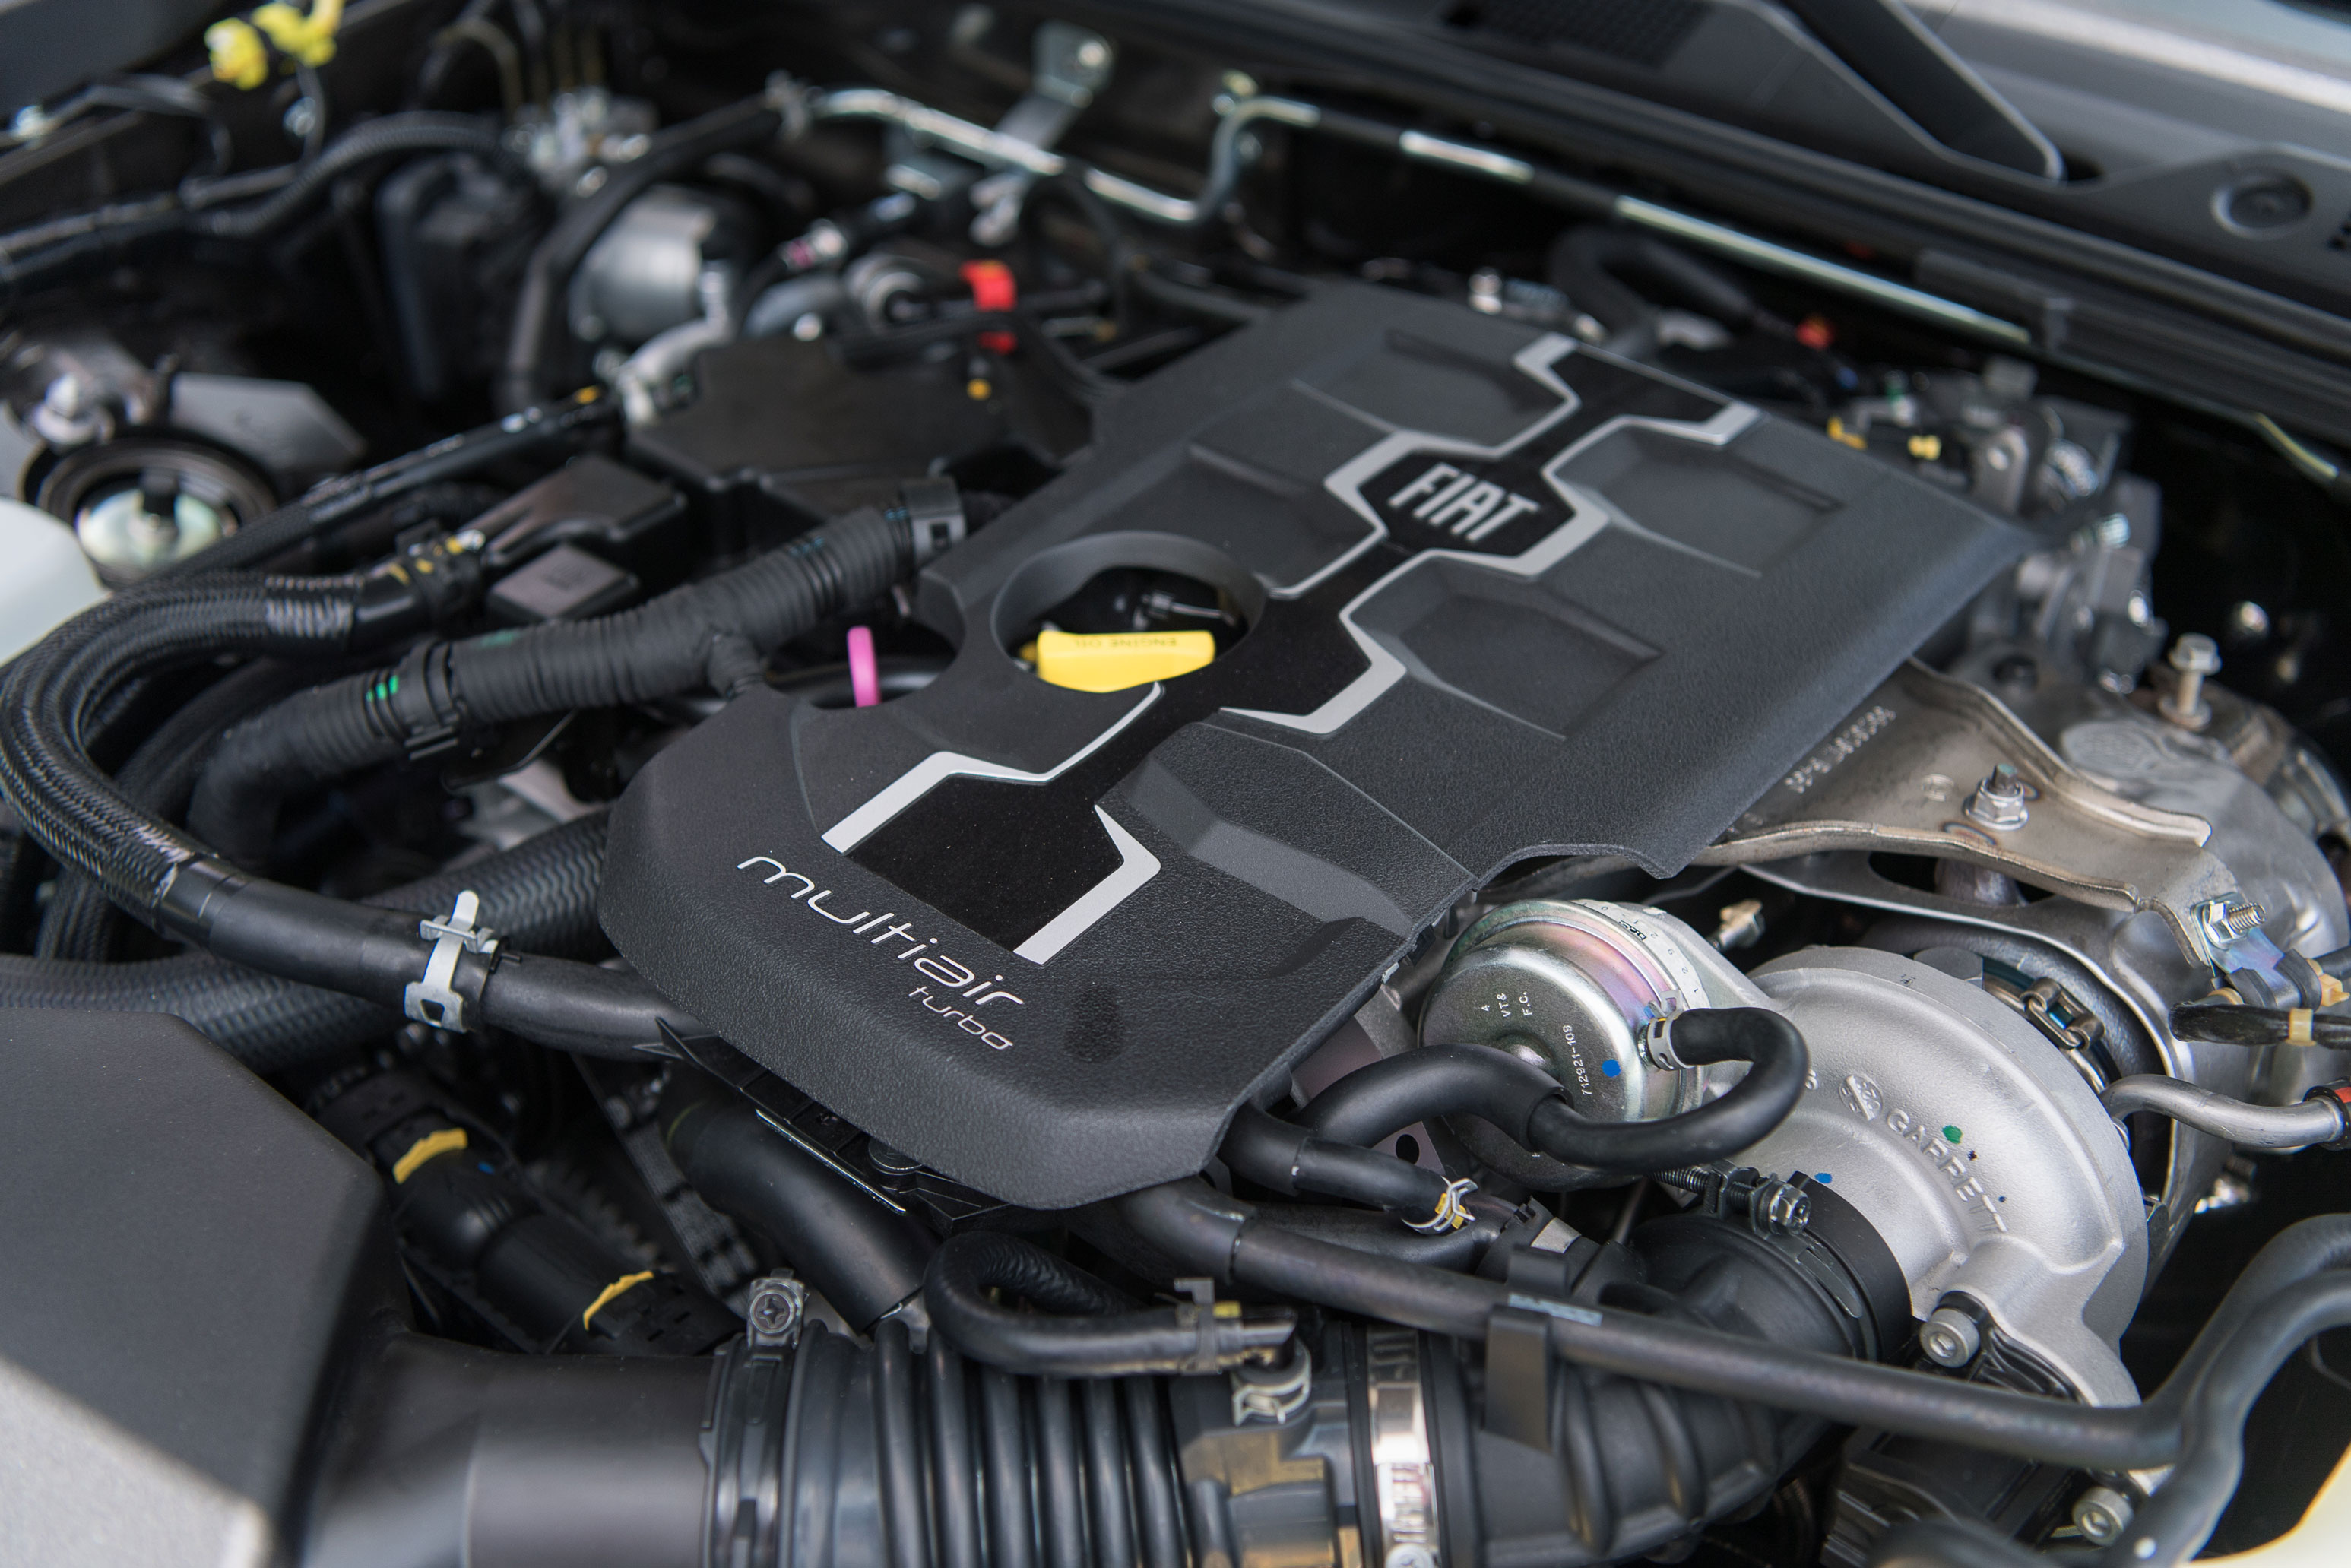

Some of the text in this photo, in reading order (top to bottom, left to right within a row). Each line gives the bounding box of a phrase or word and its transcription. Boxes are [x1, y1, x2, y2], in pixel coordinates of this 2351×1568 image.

[1388, 462, 1541, 542] FIAT
[1110, 638, 1177, 648] ENGINE
[737, 856, 1024, 1006] multiair
[908, 986, 1015, 1050] turbo
[1887, 1107, 2008, 1233] GARRETT
